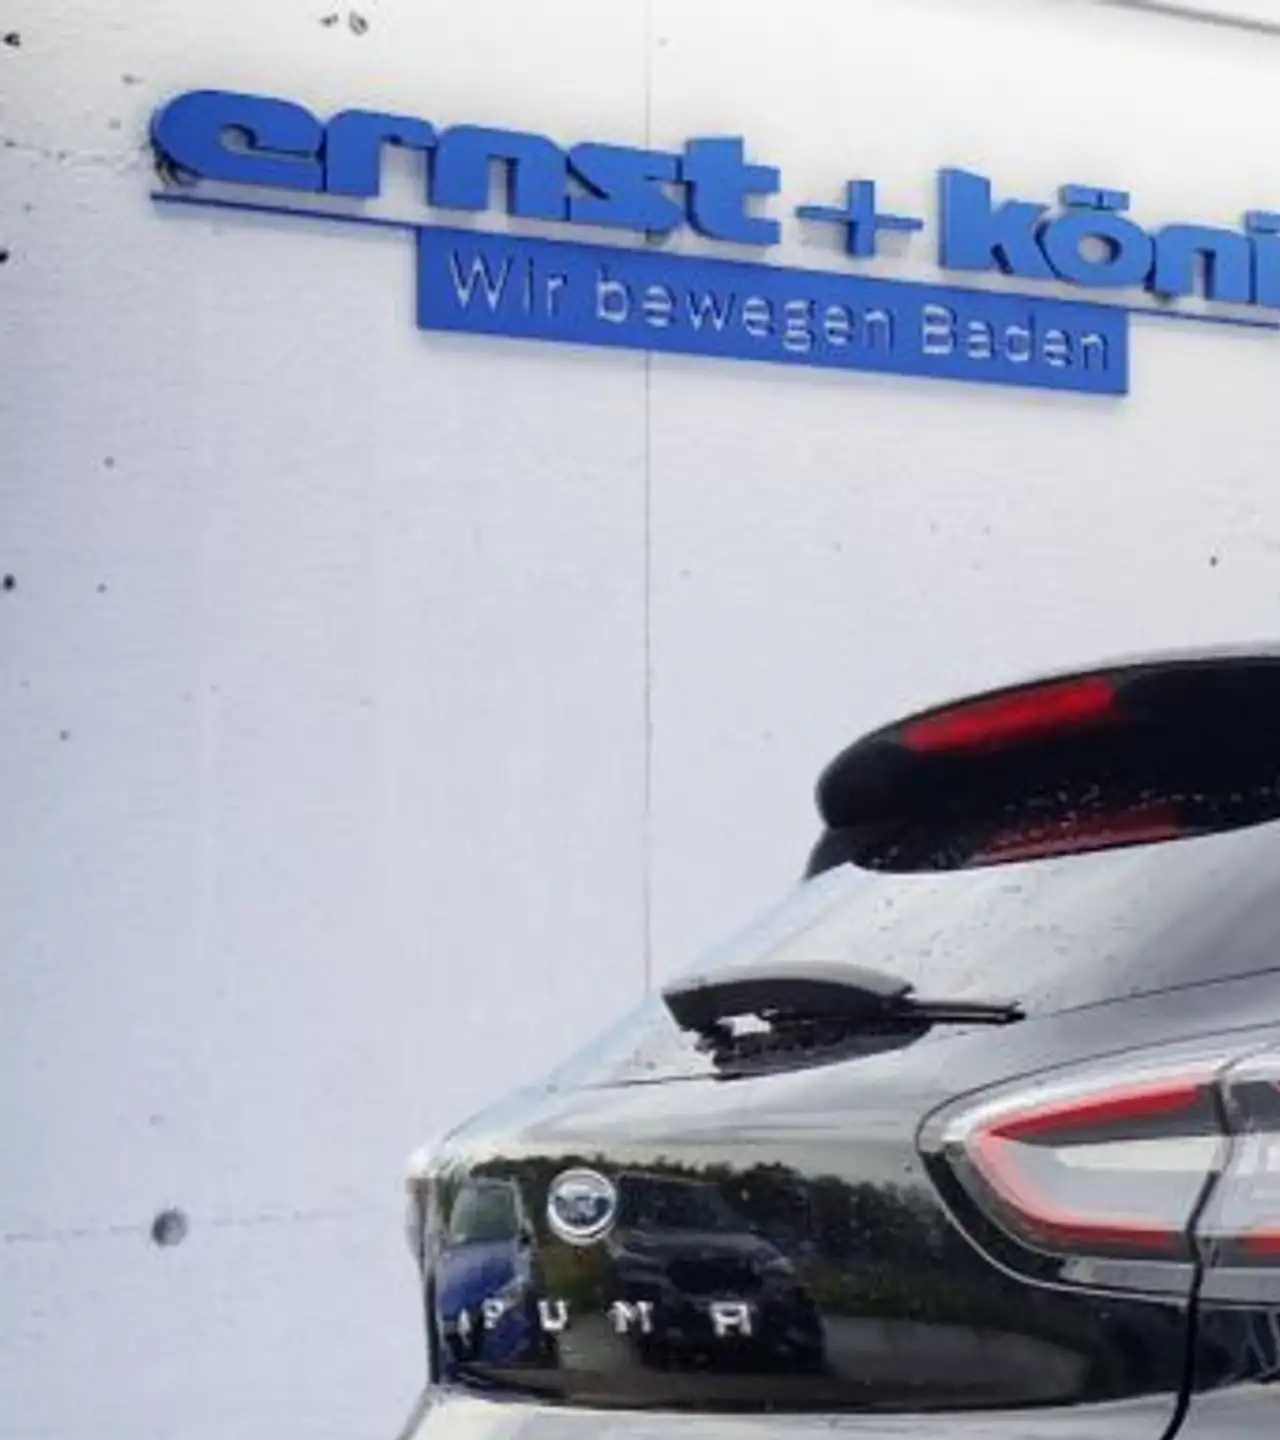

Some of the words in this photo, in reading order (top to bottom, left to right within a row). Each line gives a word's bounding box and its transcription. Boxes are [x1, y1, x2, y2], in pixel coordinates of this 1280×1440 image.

[449, 247, 568, 316] Wir
[595, 268, 895, 353] bewegen
[920, 302, 1112, 372] Baden
